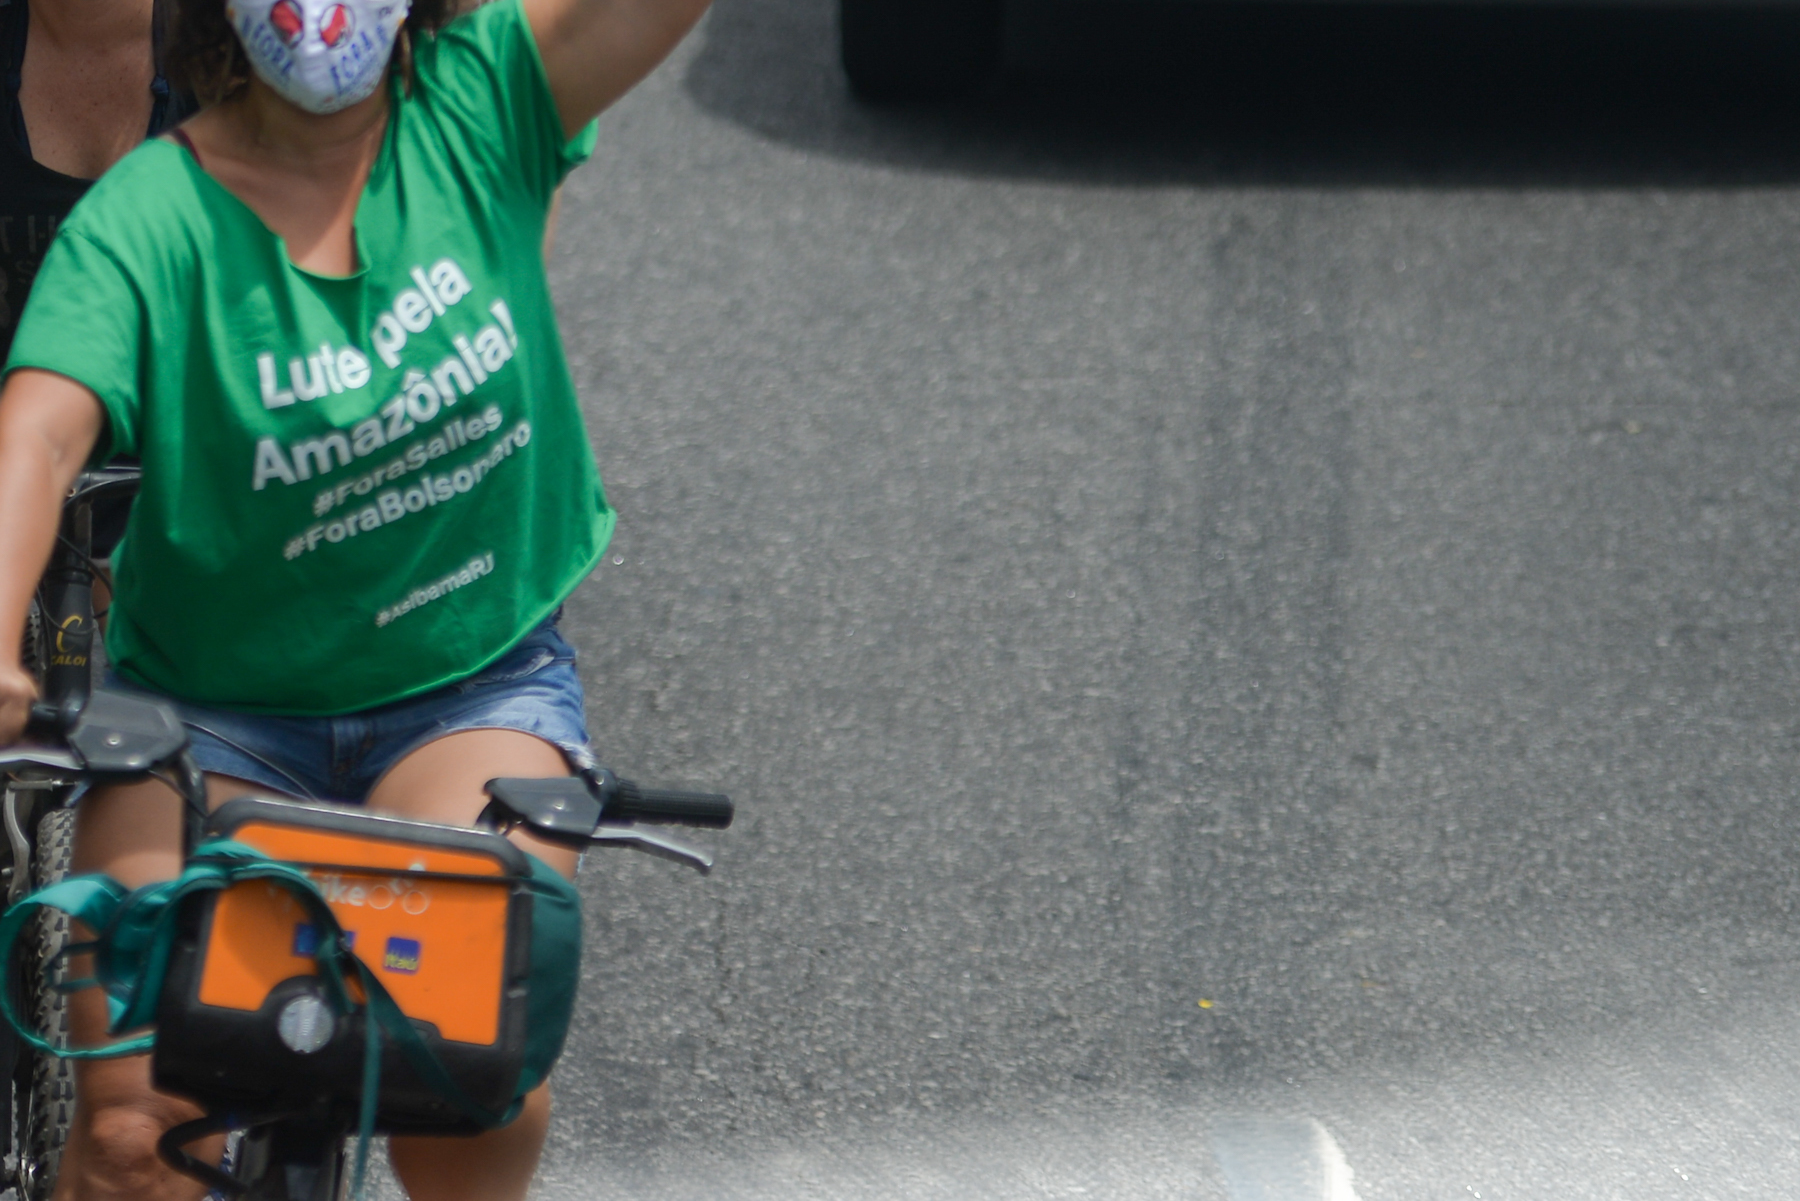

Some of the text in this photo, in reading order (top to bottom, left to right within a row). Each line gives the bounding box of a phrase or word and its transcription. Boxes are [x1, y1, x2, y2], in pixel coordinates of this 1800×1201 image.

[252, 300, 518, 491] Amazônia!
[257, 258, 473, 410] Lute pela
[283, 420, 532, 561] #ForaBolsonaro
[313, 405, 503, 517] #ForaSalles
